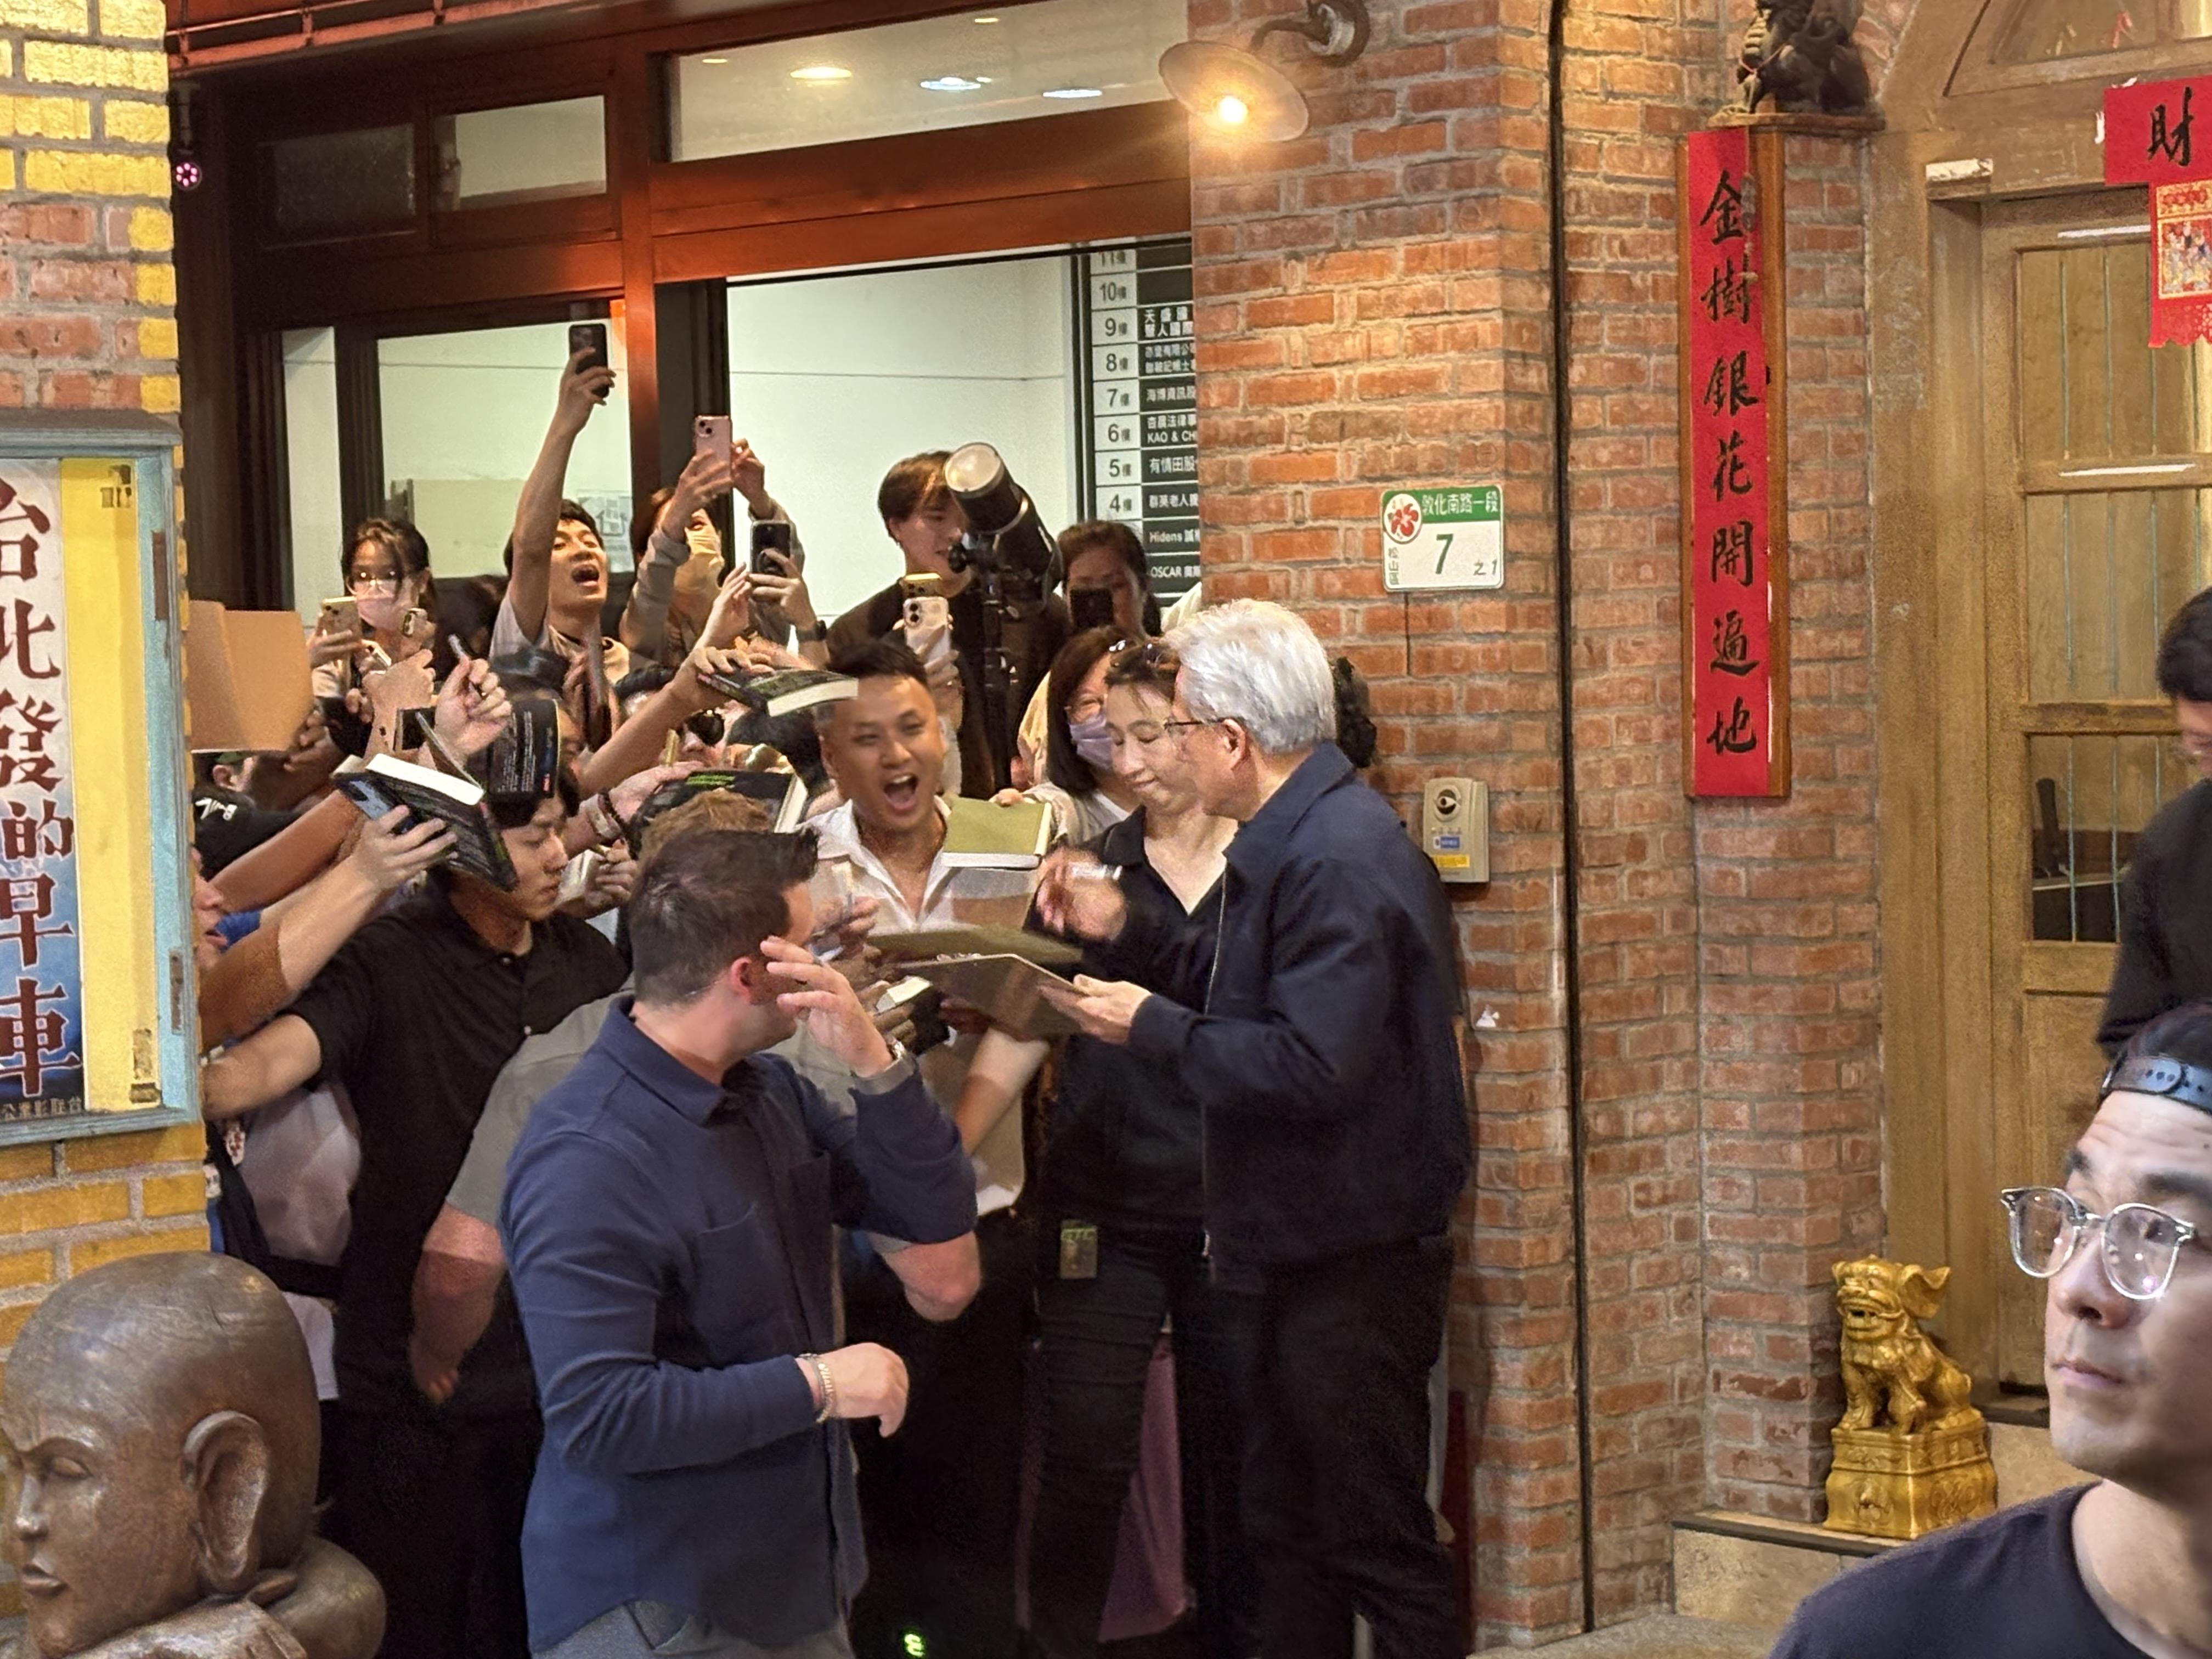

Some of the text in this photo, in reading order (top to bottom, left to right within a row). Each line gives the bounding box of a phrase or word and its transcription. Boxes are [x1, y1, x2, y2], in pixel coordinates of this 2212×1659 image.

[2147, 86, 2195, 167] 財
[1147, 431, 1169, 444] KAO
[1171, 430, 1179, 443] &
[1421, 490, 1498, 516] 敦化南路一段
[1435, 533, 1454, 574] 7
[1150, 566, 1183, 579] OSCAR
